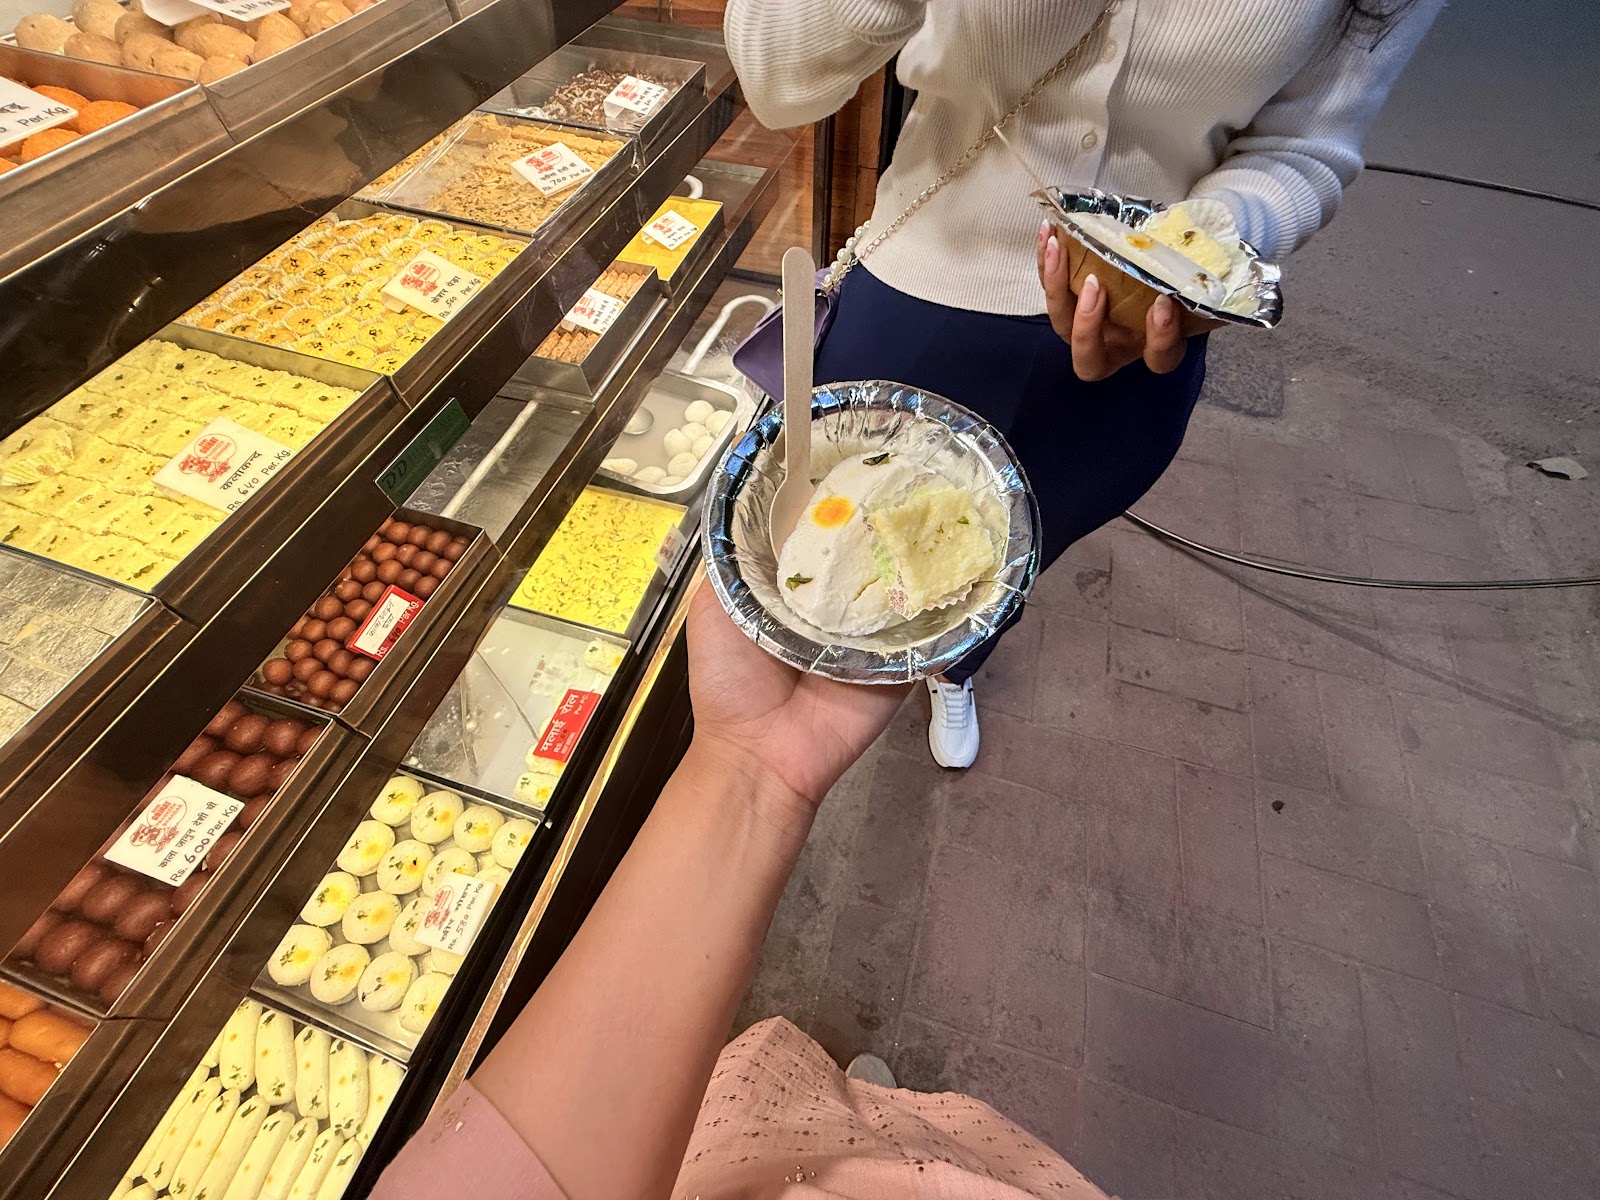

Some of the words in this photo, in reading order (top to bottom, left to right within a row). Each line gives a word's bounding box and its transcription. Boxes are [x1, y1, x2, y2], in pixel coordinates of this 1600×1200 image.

[550, 176, 567, 186] 700
[219, 450, 263, 491] कलाकन्द
[238, 478, 259, 496] 640
[260, 462, 280, 476] Per.
[376, 646, 389, 658] Rs.
[389, 628, 402, 643] 640
[540, 719, 566, 752] मलाई
[559, 694, 579, 715] रोल
[158, 850, 178, 868] काला
[175, 828, 196, 847] जामुन
[192, 812, 209, 827] देशी
[206, 801, 218, 810] घी
[170, 867, 188, 882] Rs.
[184, 838, 210, 864] 600
[207, 820, 226, 836] Per.
[222, 804, 239, 818] Kg.
